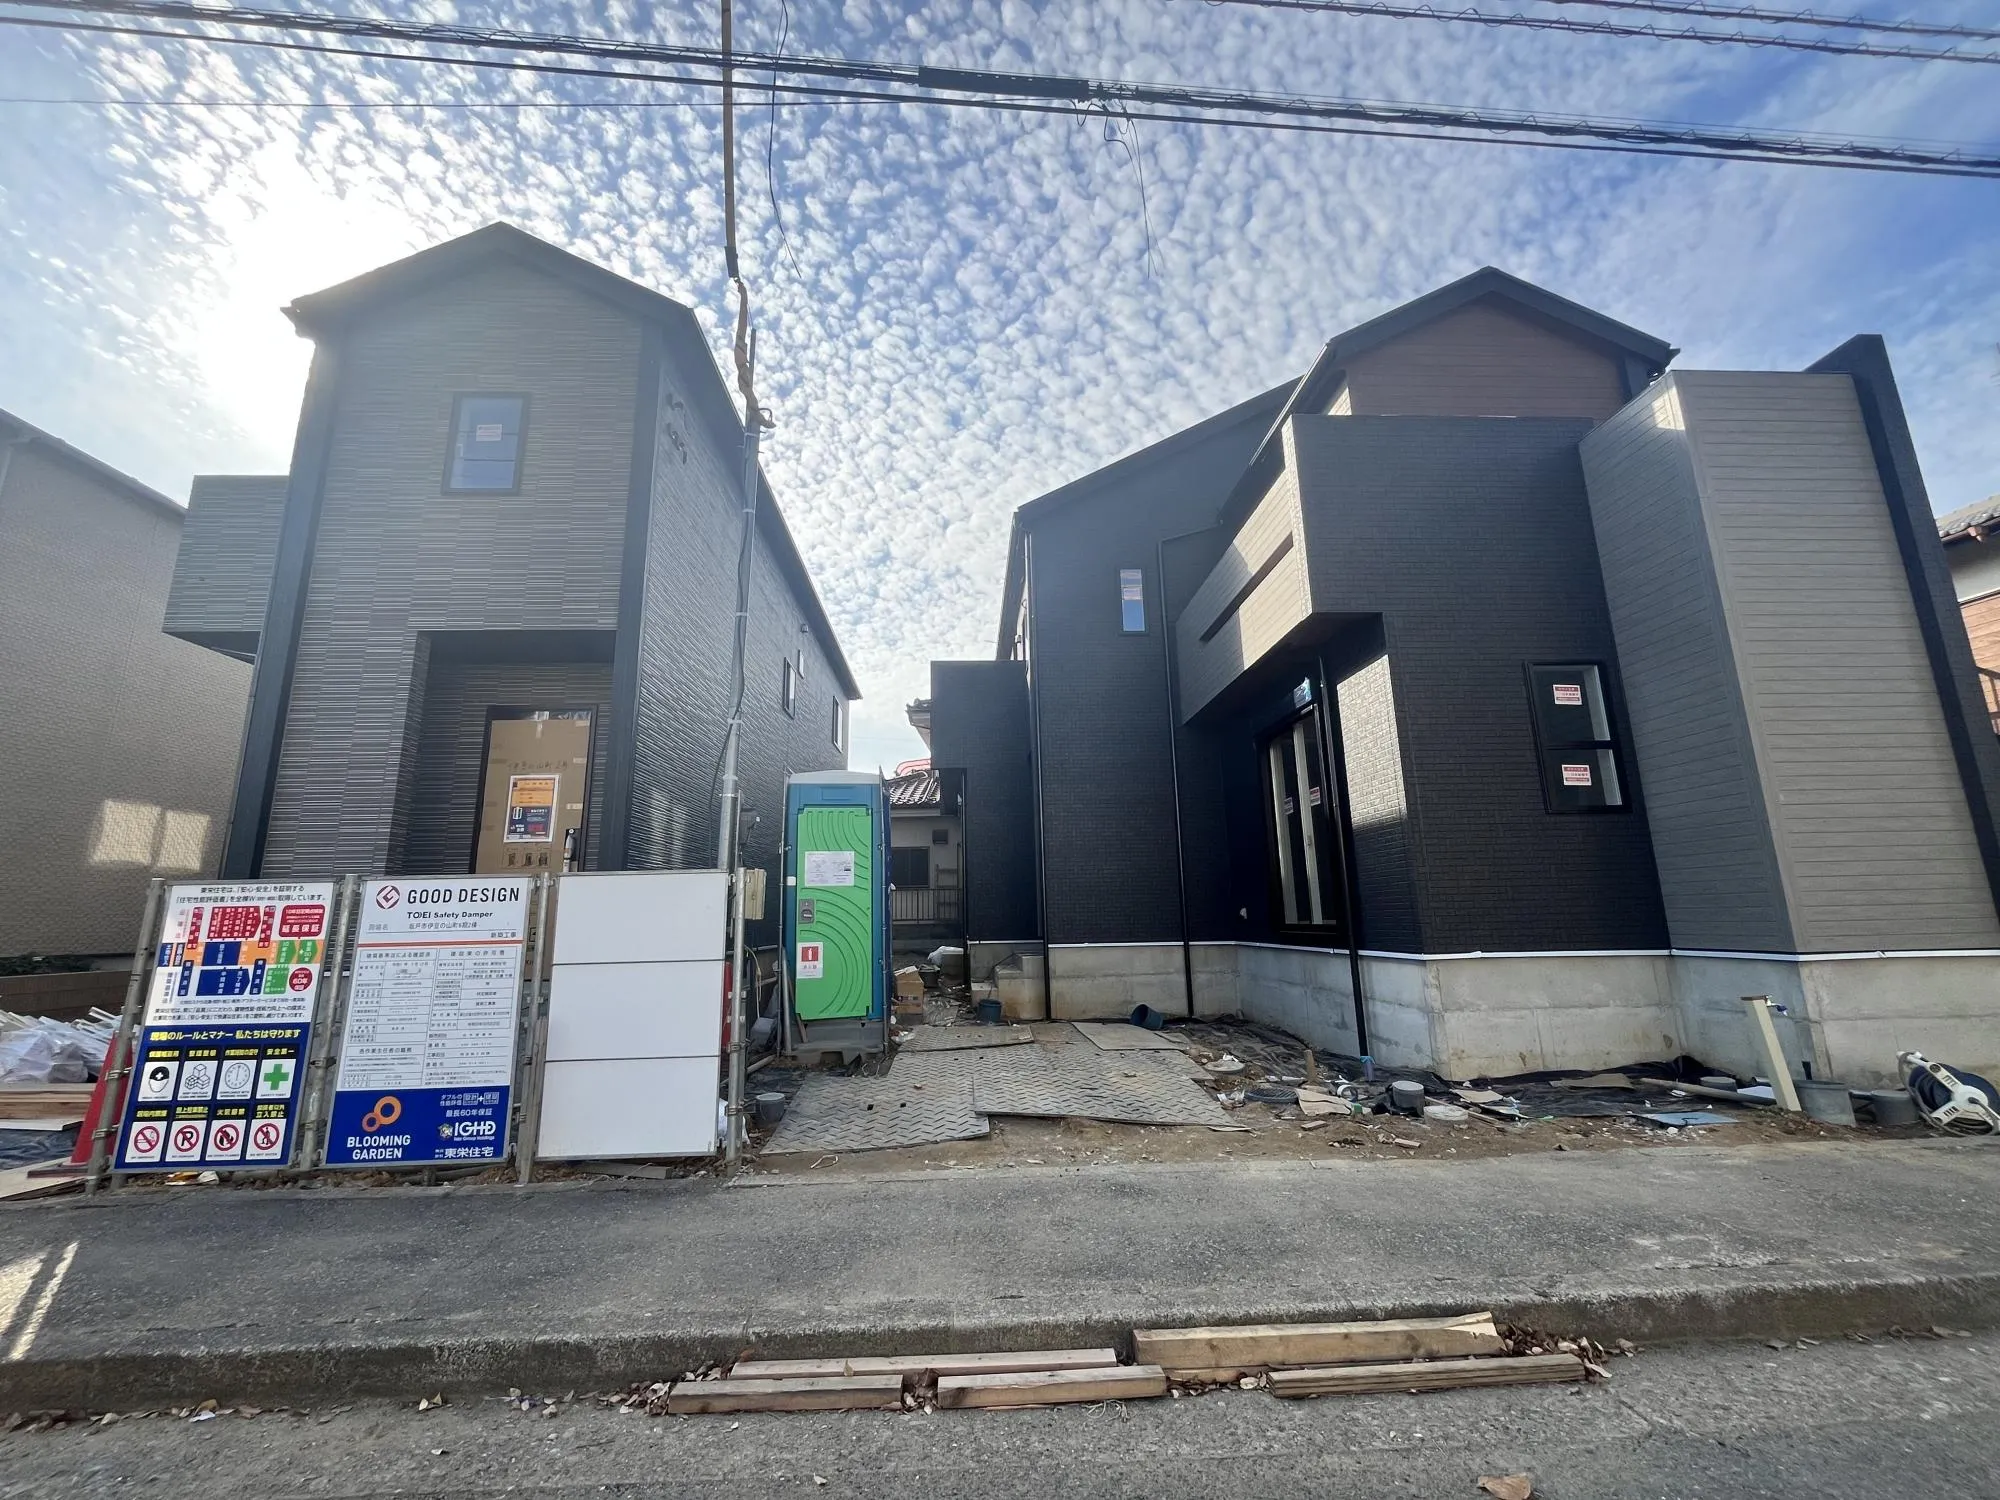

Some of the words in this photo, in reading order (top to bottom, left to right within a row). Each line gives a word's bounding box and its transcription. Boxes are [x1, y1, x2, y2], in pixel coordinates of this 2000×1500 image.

[407, 889, 452, 904] GOOD
[458, 887, 519, 903] DESIGN
[433, 911, 460, 919] Safety
[235, 1029, 301, 1039] 私たちは守ります
[266, 1048, 295, 1056] 安全第一
[454, 1120, 497, 1136] IGHD
[346, 1135, 411, 1147] BLOOMING
[352, 1147, 402, 1160] GARDEN
[444, 1146, 494, 1158] 東栄住宅
